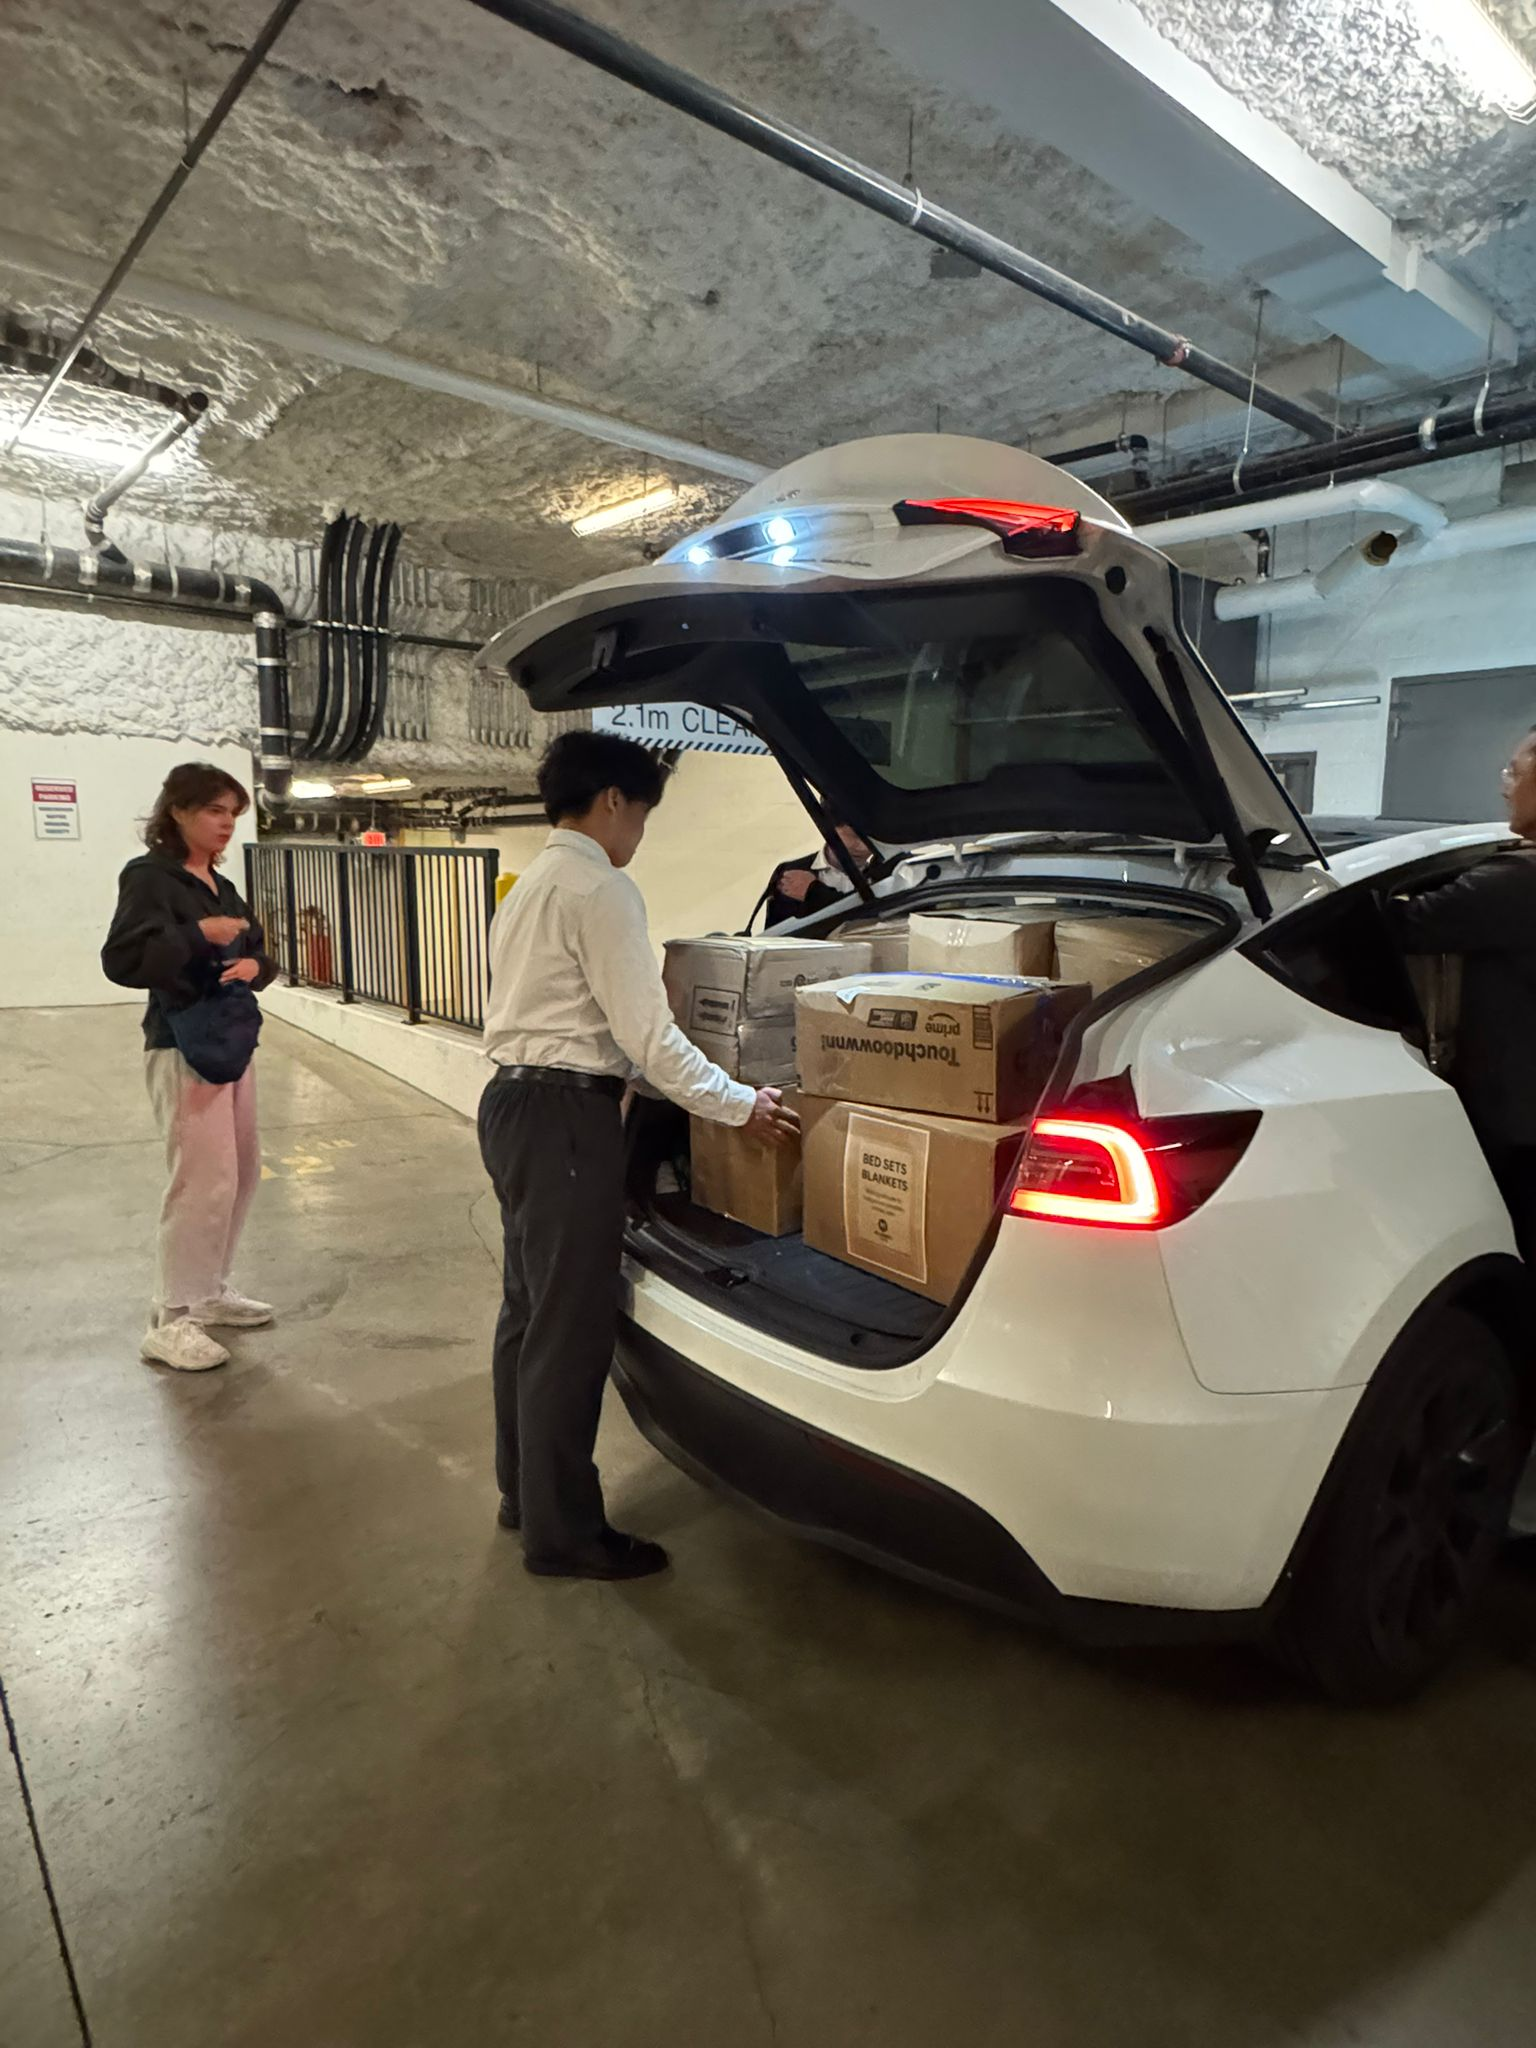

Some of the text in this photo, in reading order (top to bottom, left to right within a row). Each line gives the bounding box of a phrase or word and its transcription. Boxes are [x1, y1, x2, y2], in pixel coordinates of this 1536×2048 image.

[611, 703, 754, 738] 2.1m CLEA
[925, 1022, 961, 1037] prime
[863, 1153, 908, 1176] BED SETS
[861, 1169, 908, 1192] BLANKETS
